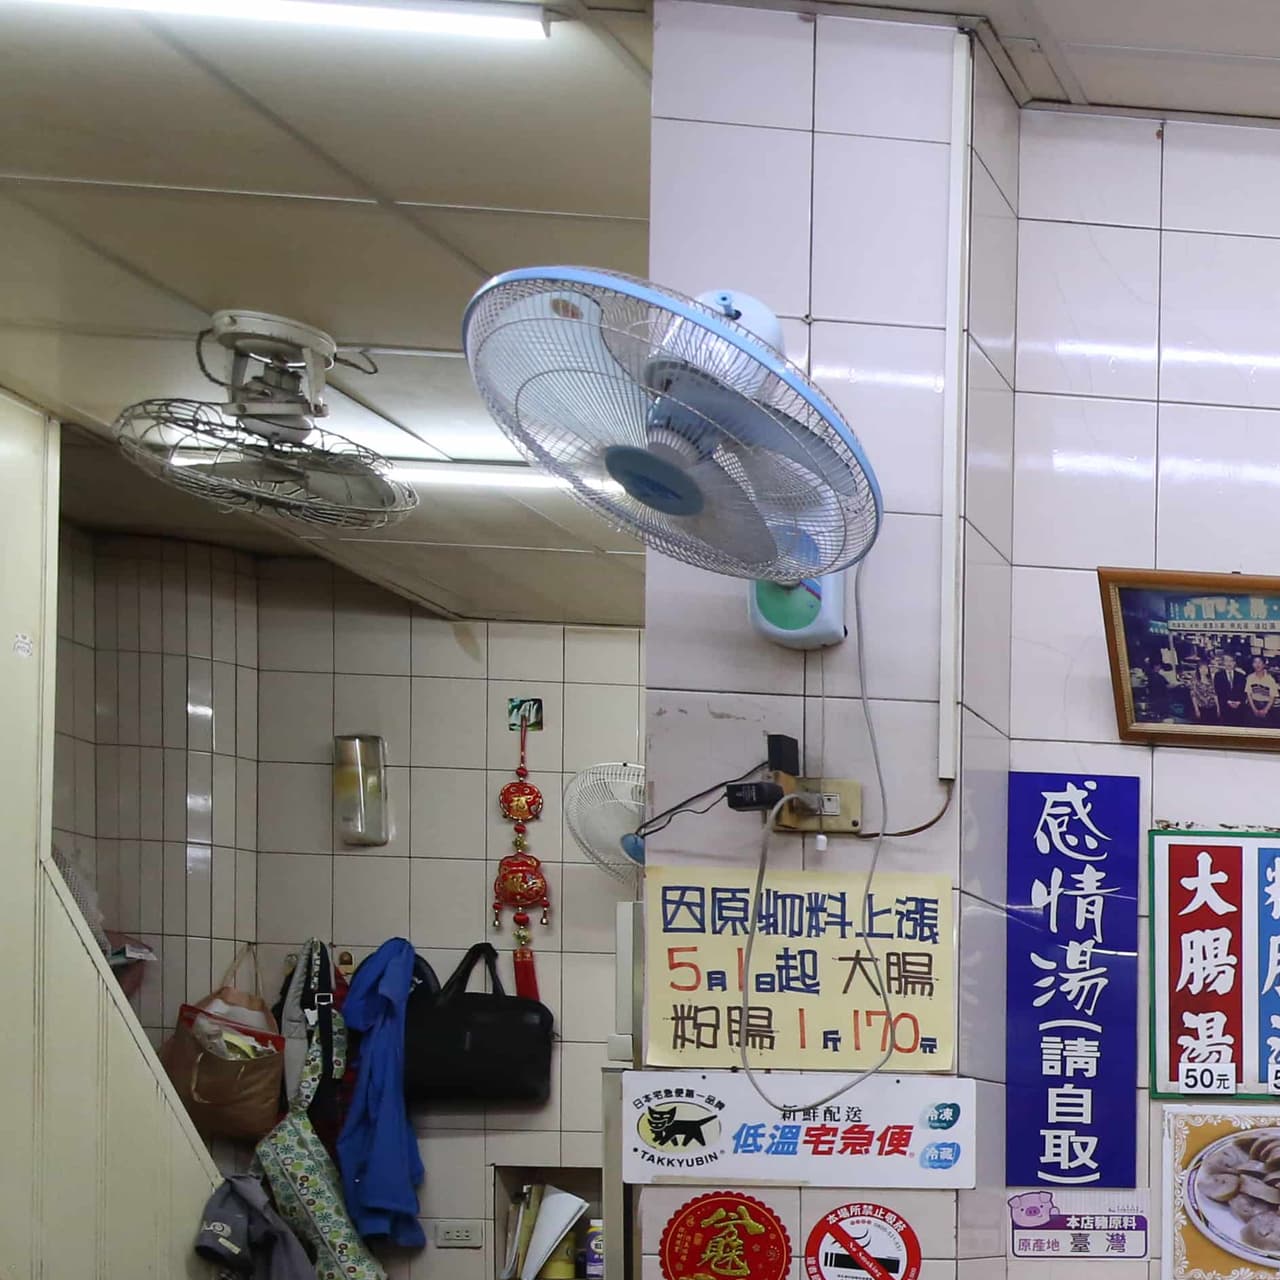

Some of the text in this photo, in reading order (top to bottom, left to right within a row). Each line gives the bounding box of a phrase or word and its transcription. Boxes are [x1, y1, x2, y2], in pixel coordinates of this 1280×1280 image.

[661, 885, 940, 945] 因原物料上漲
[1176, 851, 1238, 1064] 大腸湯
[667, 946, 939, 999] 5月1日起 大腸
[1184, 1068, 1230, 1090] 50元
[632, 1088, 726, 1111] 日本宅急便第一品牌
[781, 1103, 862, 1122] 新鮮配送
[731, 1123, 914, 1157] 低溫宅急便
[640, 1149, 719, 1169] TAKKYUBIN
[1018, 1238, 1060, 1252] 原產地
